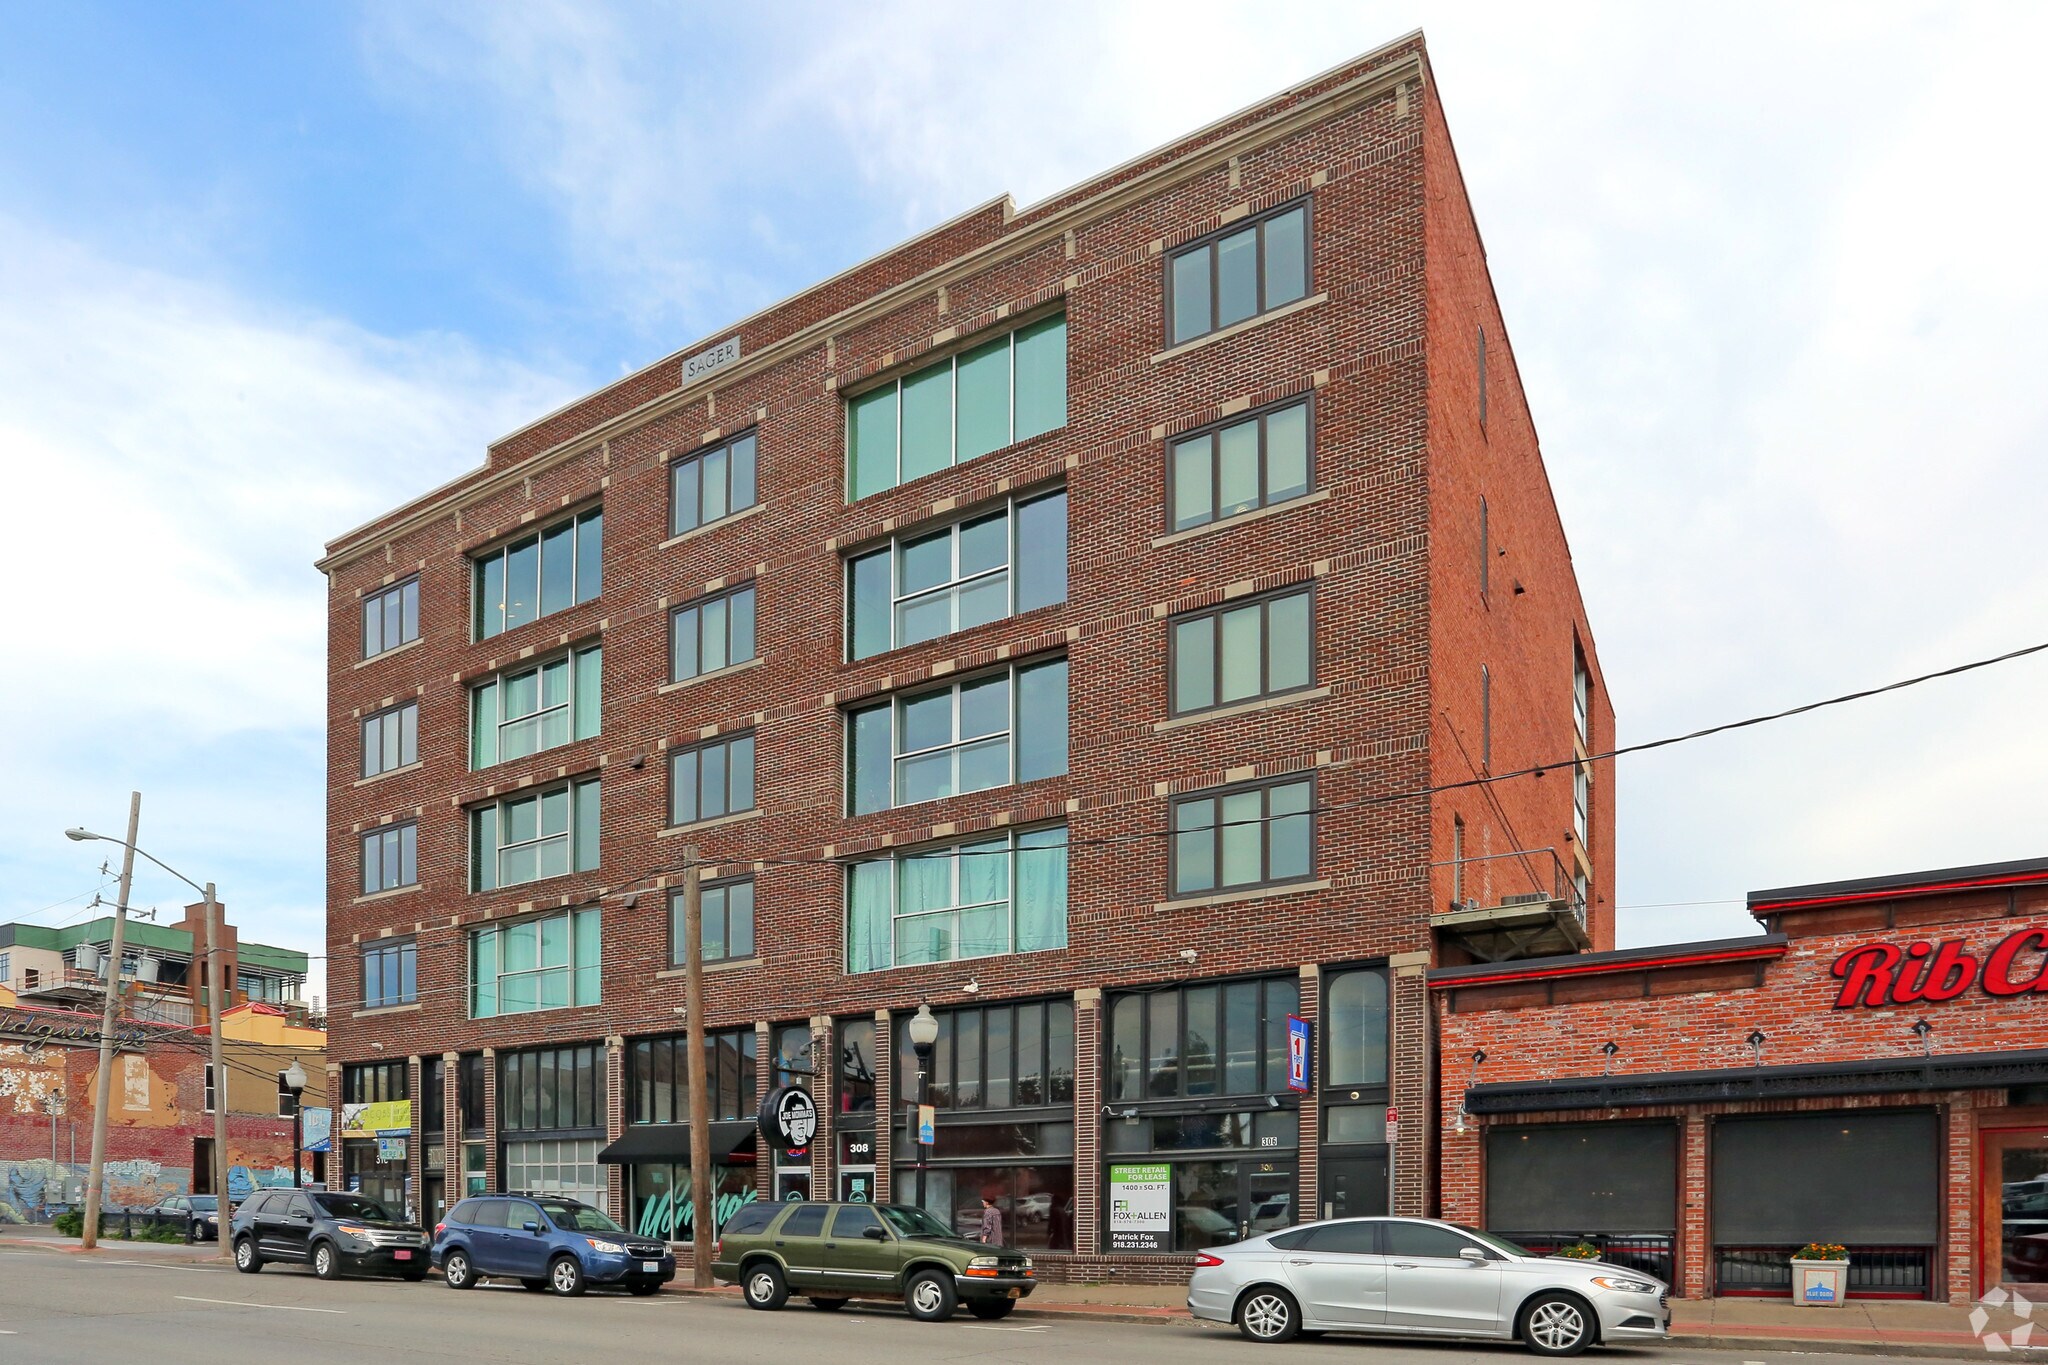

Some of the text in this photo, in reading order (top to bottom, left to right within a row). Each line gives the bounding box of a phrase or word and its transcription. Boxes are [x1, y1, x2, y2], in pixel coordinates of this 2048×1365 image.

[688, 344, 734, 377] SAGER
[1831, 927, 2048, 1011] Rib C
[1262, 1137, 1277, 1146] 306
[850, 1143, 869, 1153] 308
[381, 1150, 397, 1158] HERE
[1113, 1233, 1154, 1241] Patrick Fox
[1112, 1241, 1158, 1249] 918.231.2346
